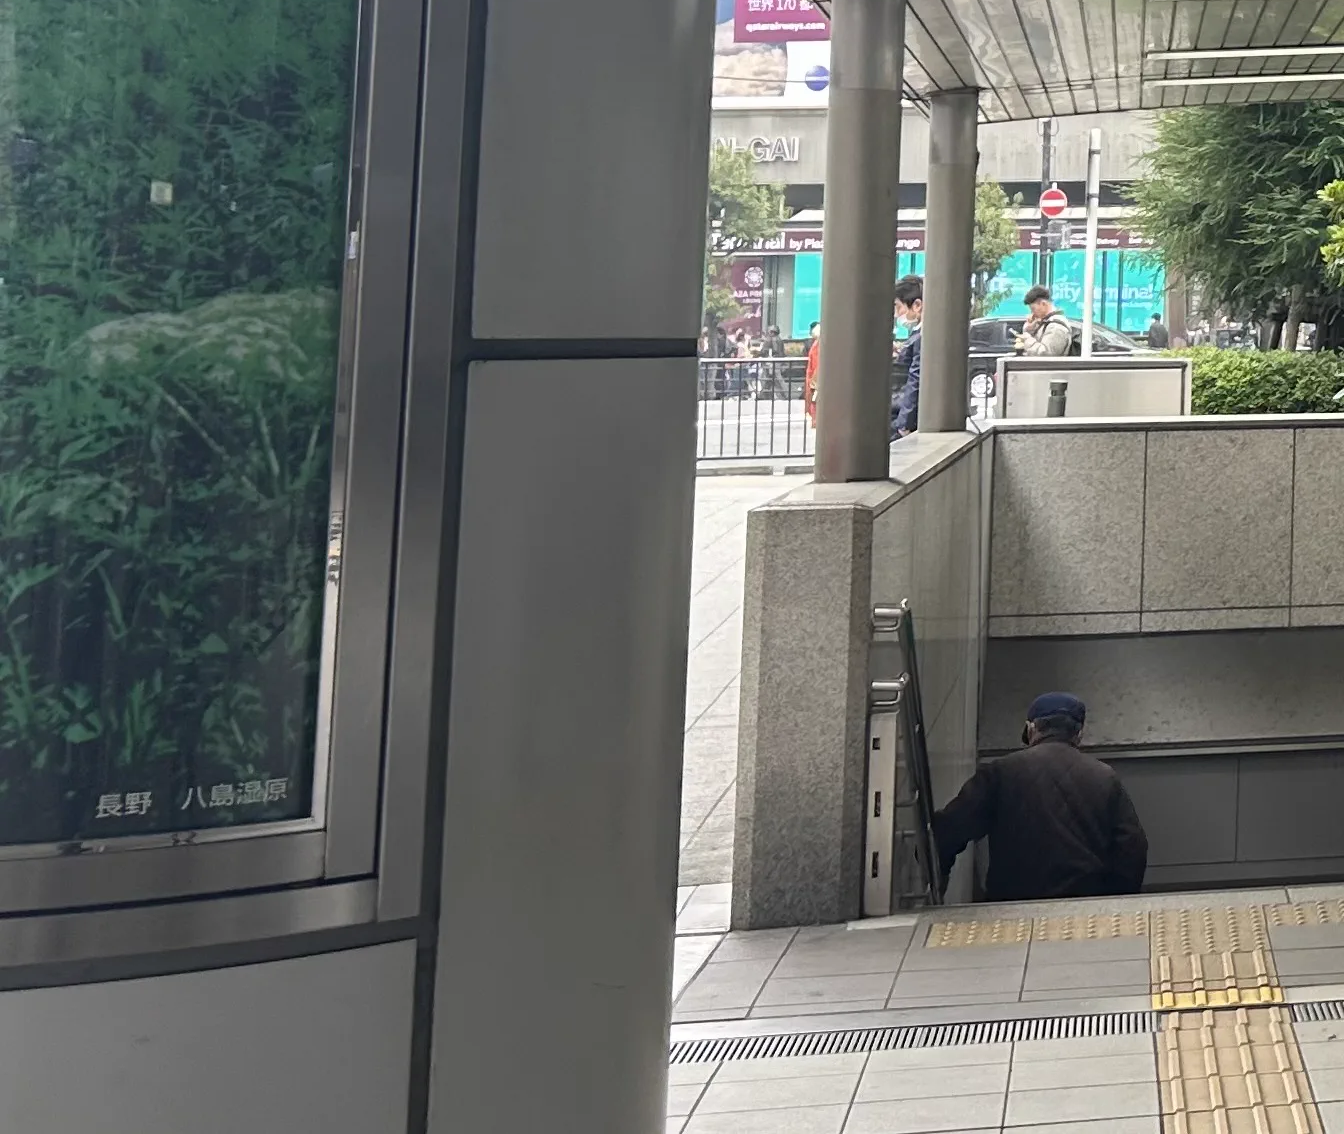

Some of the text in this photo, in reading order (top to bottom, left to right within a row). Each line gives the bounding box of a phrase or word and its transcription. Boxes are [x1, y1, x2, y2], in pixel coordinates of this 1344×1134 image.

[95, 777, 289, 818] 長野 八島湿原
